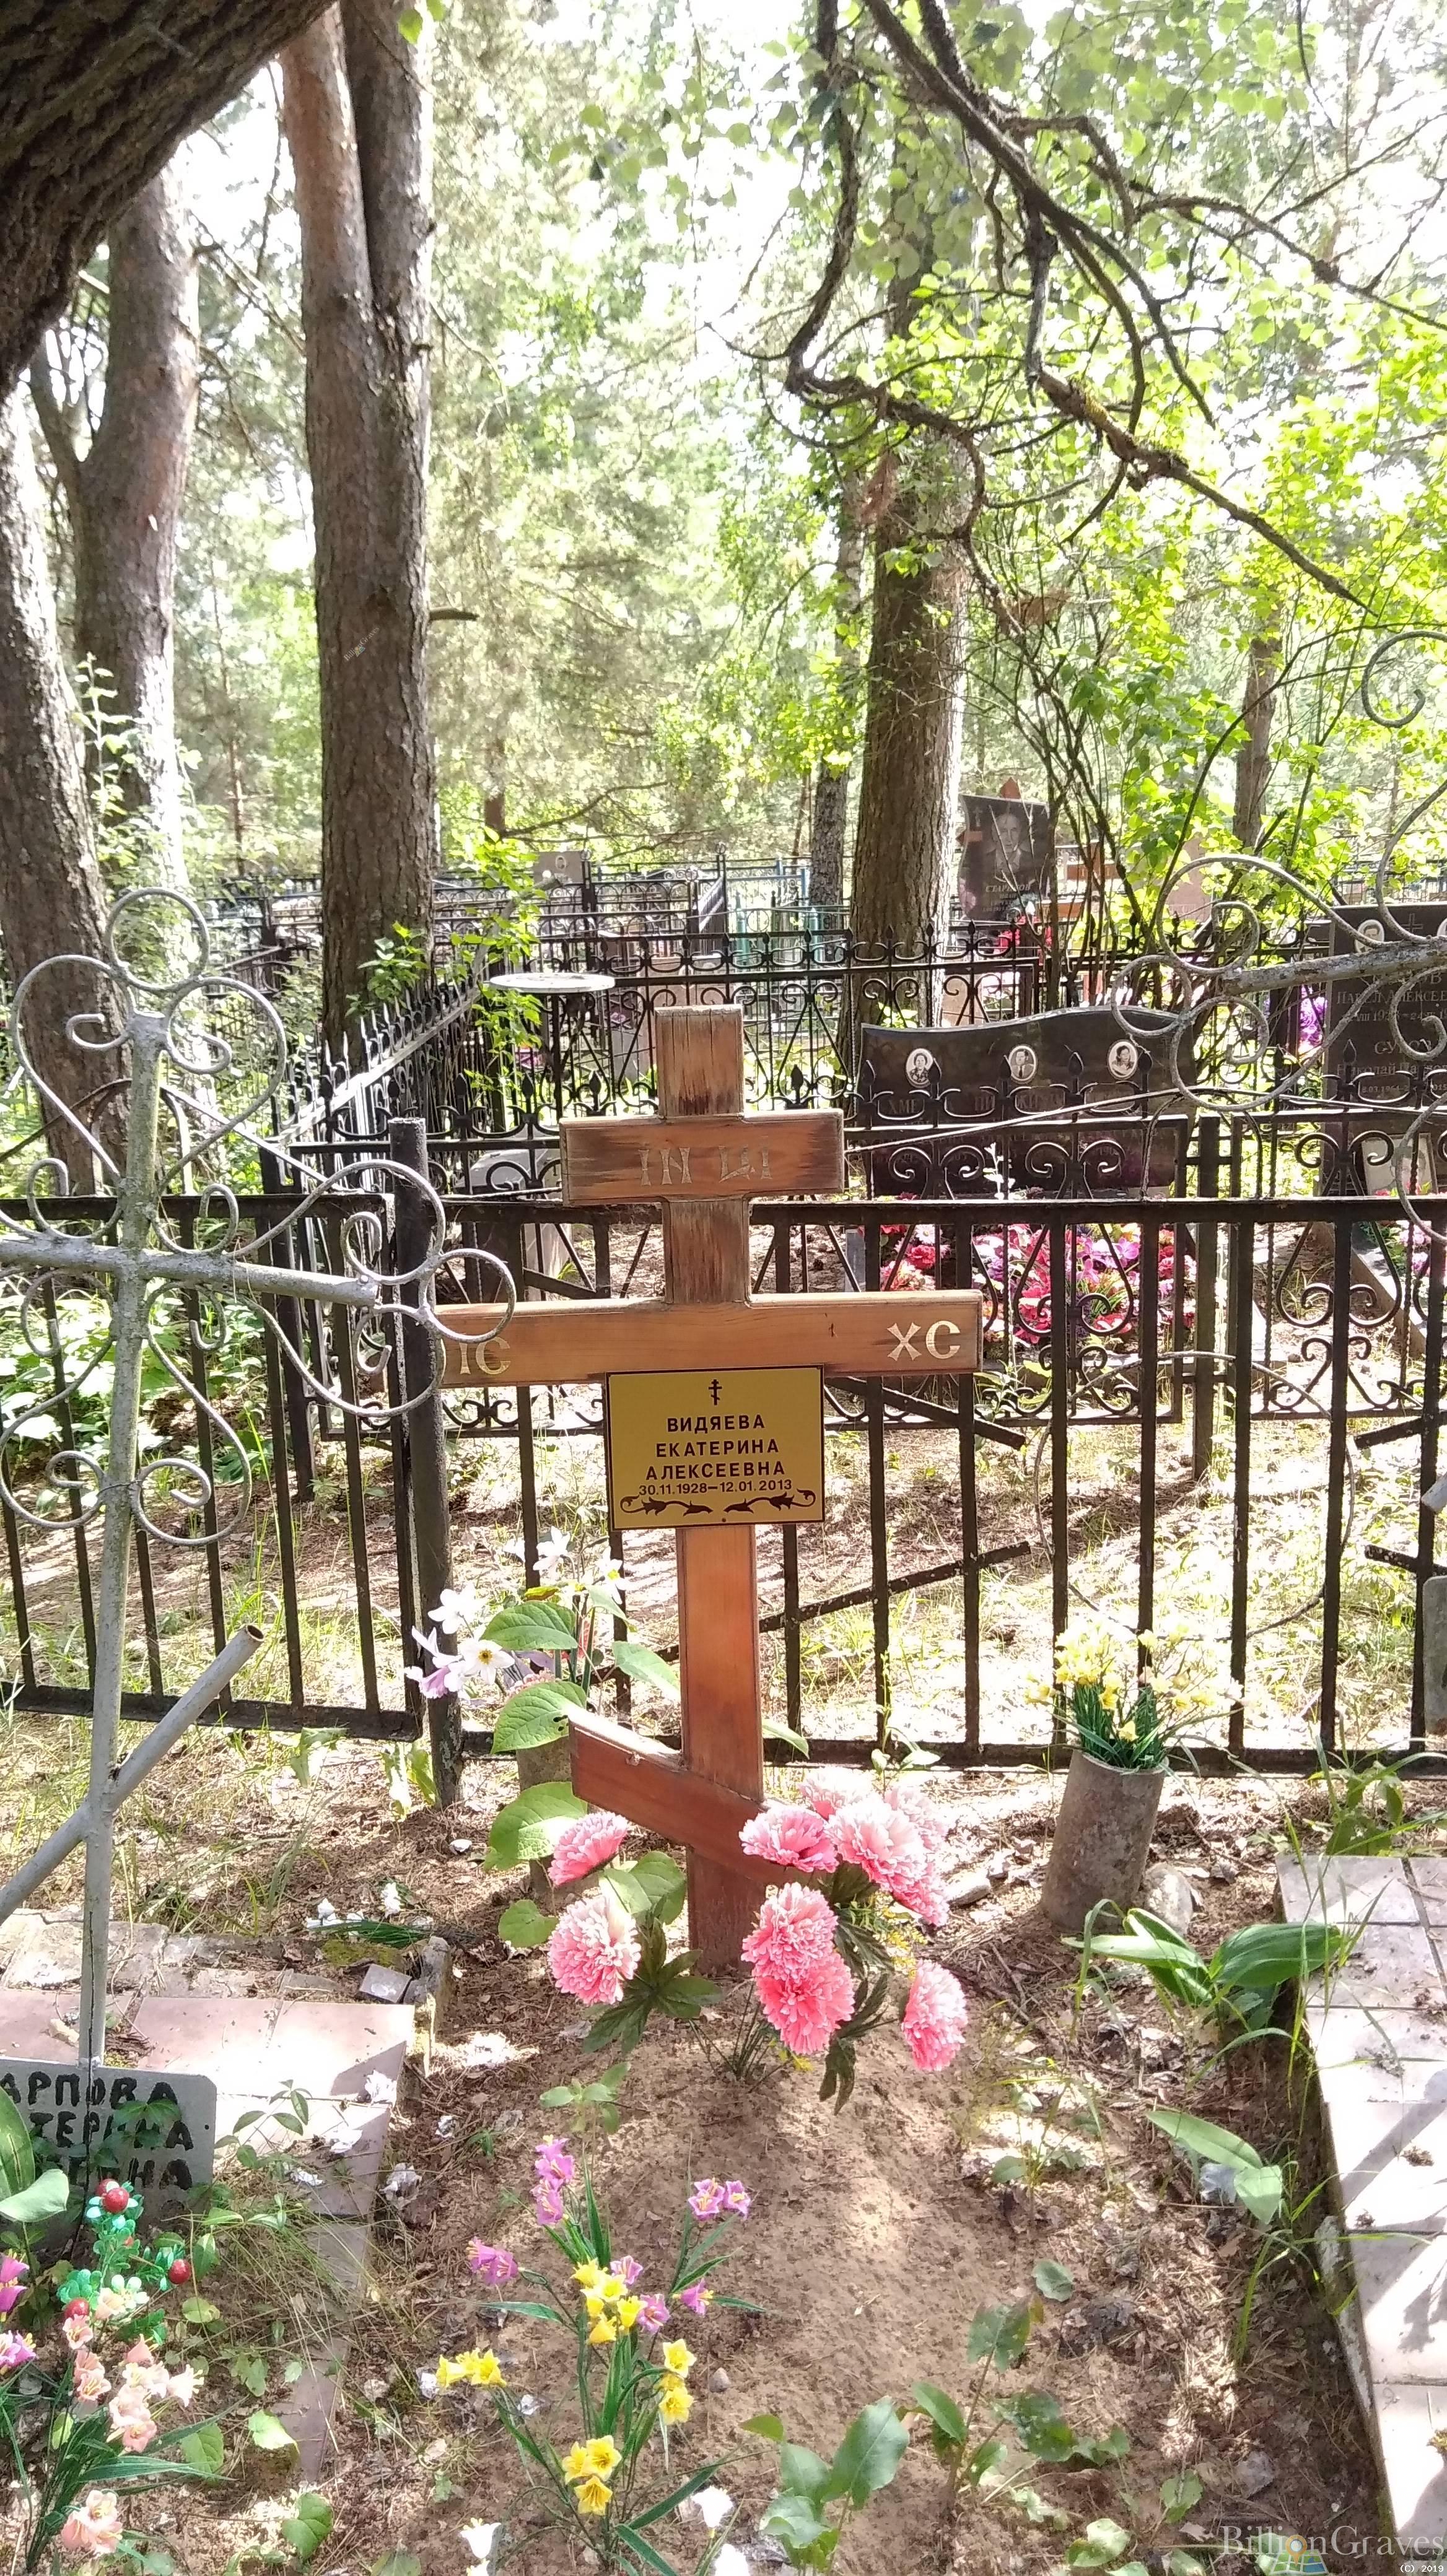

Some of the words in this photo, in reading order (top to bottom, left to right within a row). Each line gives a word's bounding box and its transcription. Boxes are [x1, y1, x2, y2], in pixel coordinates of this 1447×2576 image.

[667, 1414, 765, 1434] ВИДЯЕВА
[656, 1438, 779, 1458] ЕКАТЕРИНА
[645, 1461, 785, 1481] АЛЕКСЕЕВНА
